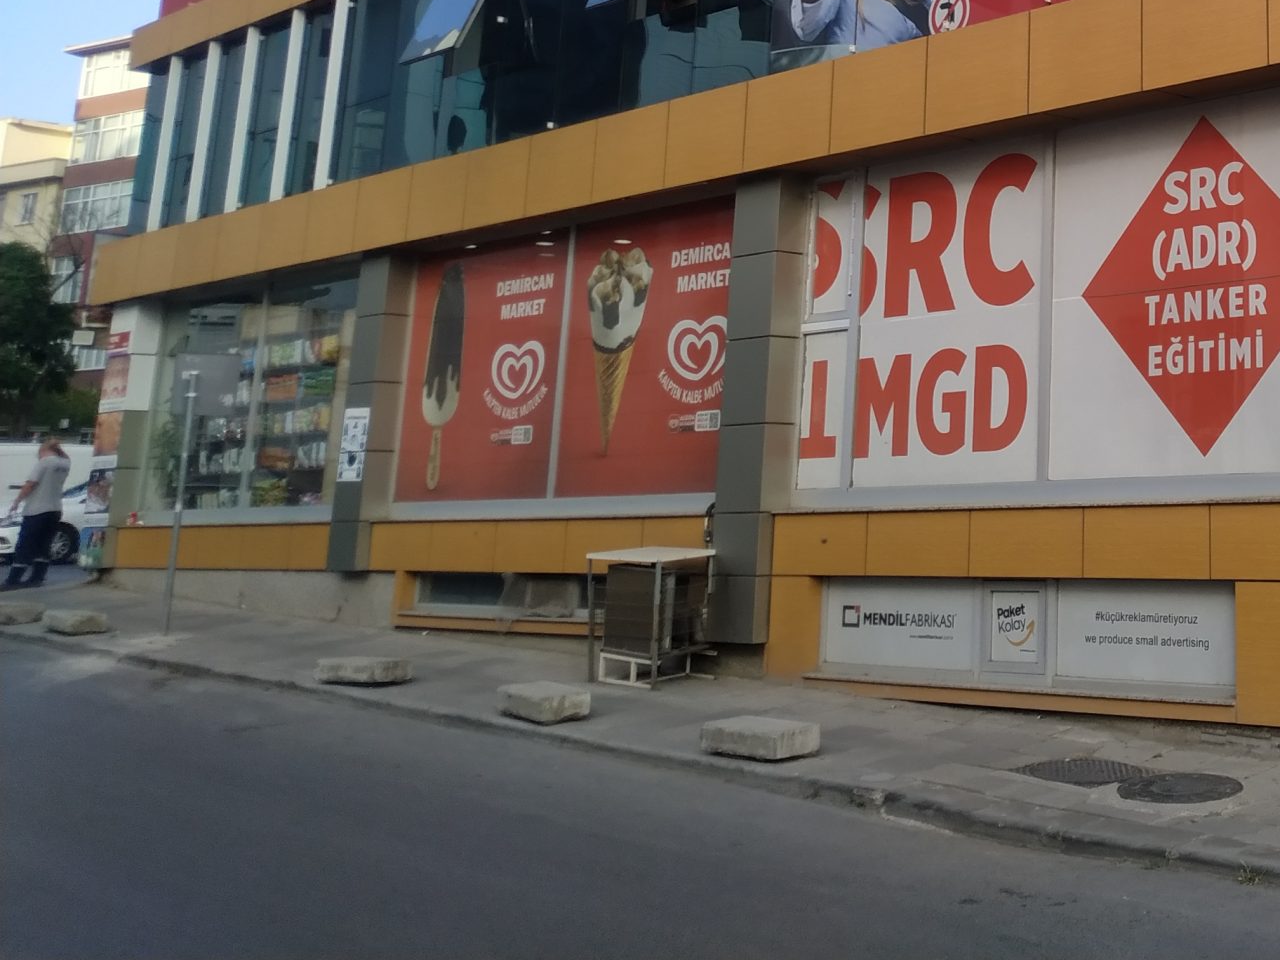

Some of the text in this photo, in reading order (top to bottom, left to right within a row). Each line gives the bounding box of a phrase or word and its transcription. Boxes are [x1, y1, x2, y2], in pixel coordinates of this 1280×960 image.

[1163, 161, 1245, 215] SRC
[671, 241, 731, 269] DEMİRCA
[1152, 218, 1257, 281] (ADR)
[496, 272, 555, 298] DEMİRCAN
[676, 268, 731, 294] MARKET
[501, 298, 547, 321] MARKET
[1144, 283, 1268, 327] TANKER
[1148, 328, 1265, 378] EĞİTİMİ
[704, 377, 724, 401] MUTL
[863, 609, 956, 629] MENDİLFABRİKASI
[996, 603, 1026, 620] Paket
[1095, 611, 1198, 626] #küçükreklamüretiyoruz
[997, 618, 1027, 634] Kolay
[1084, 634, 1210, 651] we produce small advertising
